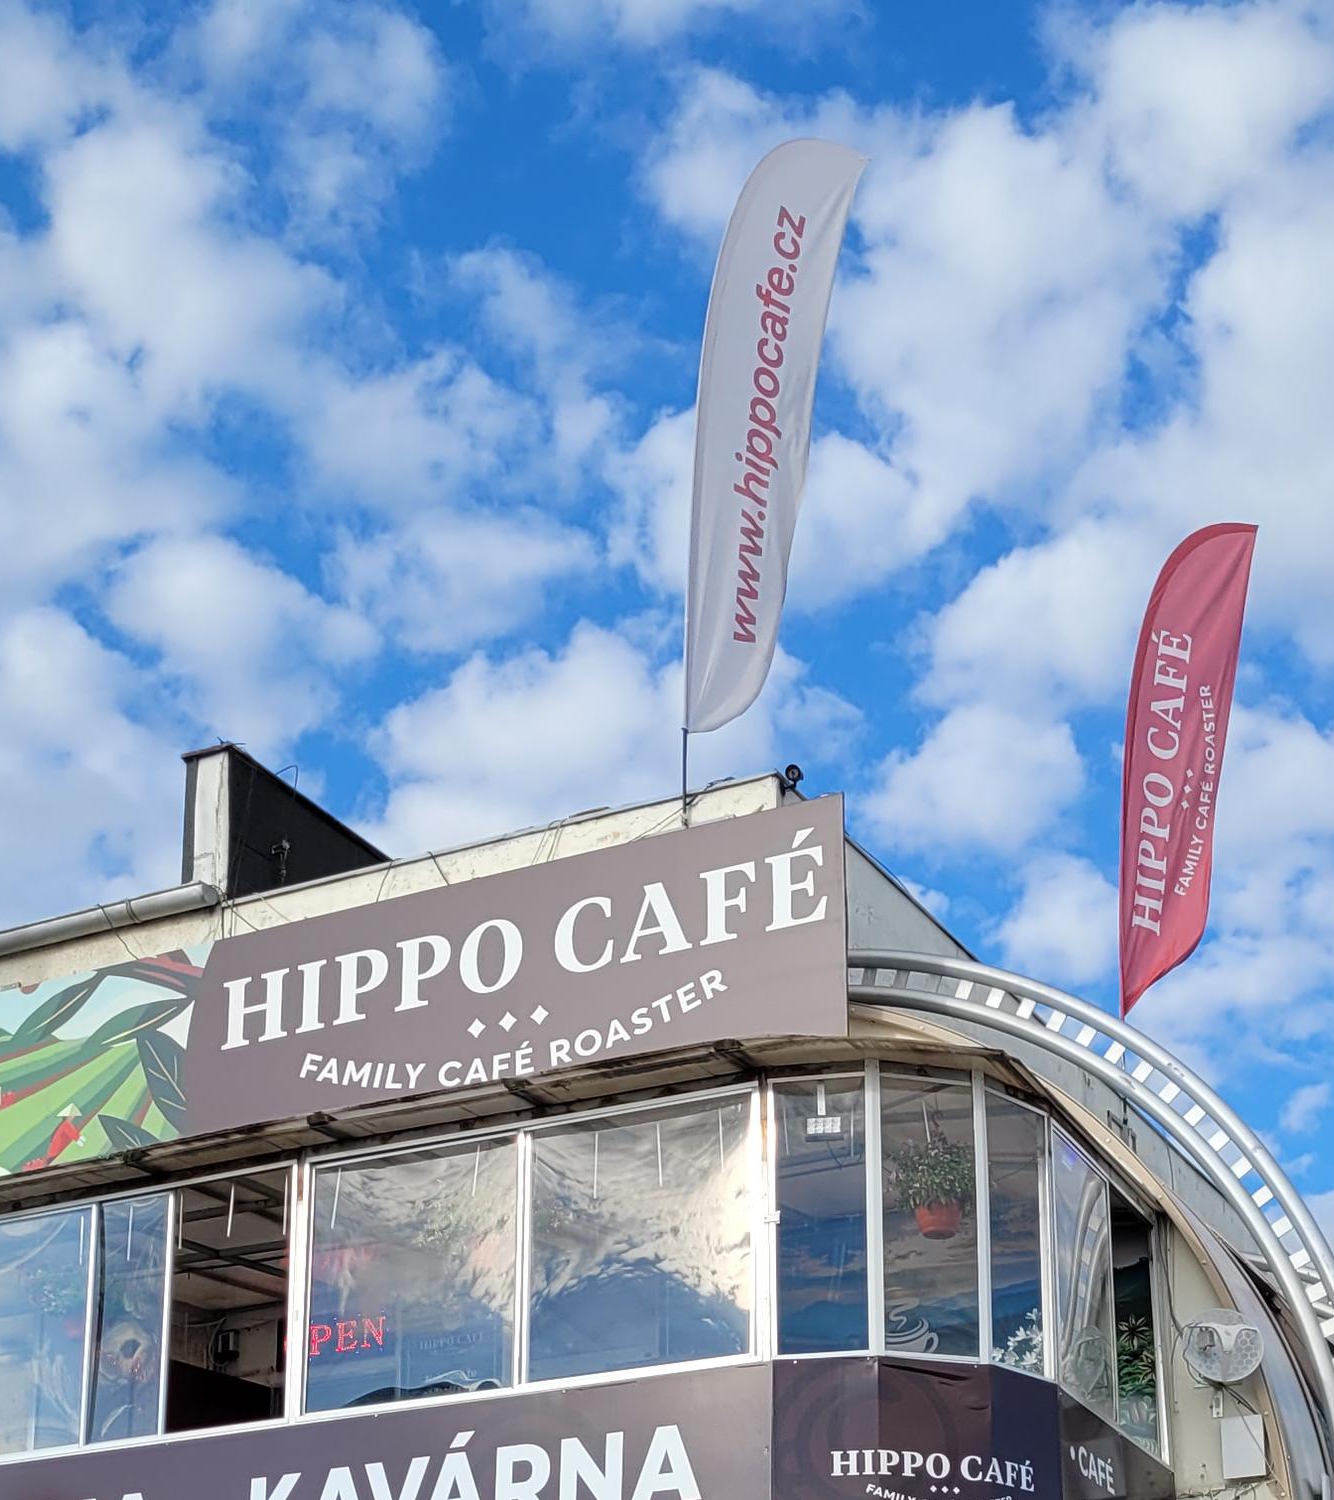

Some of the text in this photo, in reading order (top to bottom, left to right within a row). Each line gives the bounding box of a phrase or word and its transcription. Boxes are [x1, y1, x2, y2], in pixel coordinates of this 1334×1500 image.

[733, 205, 806, 645] www.hippocafe.cz
[1131, 629, 1193, 937] HIPPO CAFÉ
[1174, 684, 1217, 897] FAMILY CAFÉ ROASTER
[221, 827, 828, 1051] HIPPO CAFÉ
[299, 968, 729, 1090] FAMILY CAFÉ ROASTER
[306, 1312, 388, 1357] PEN
[831, 1448, 1036, 1493] HIPPO CAFÉ
[1078, 1446, 1116, 1496] CAFÉ
